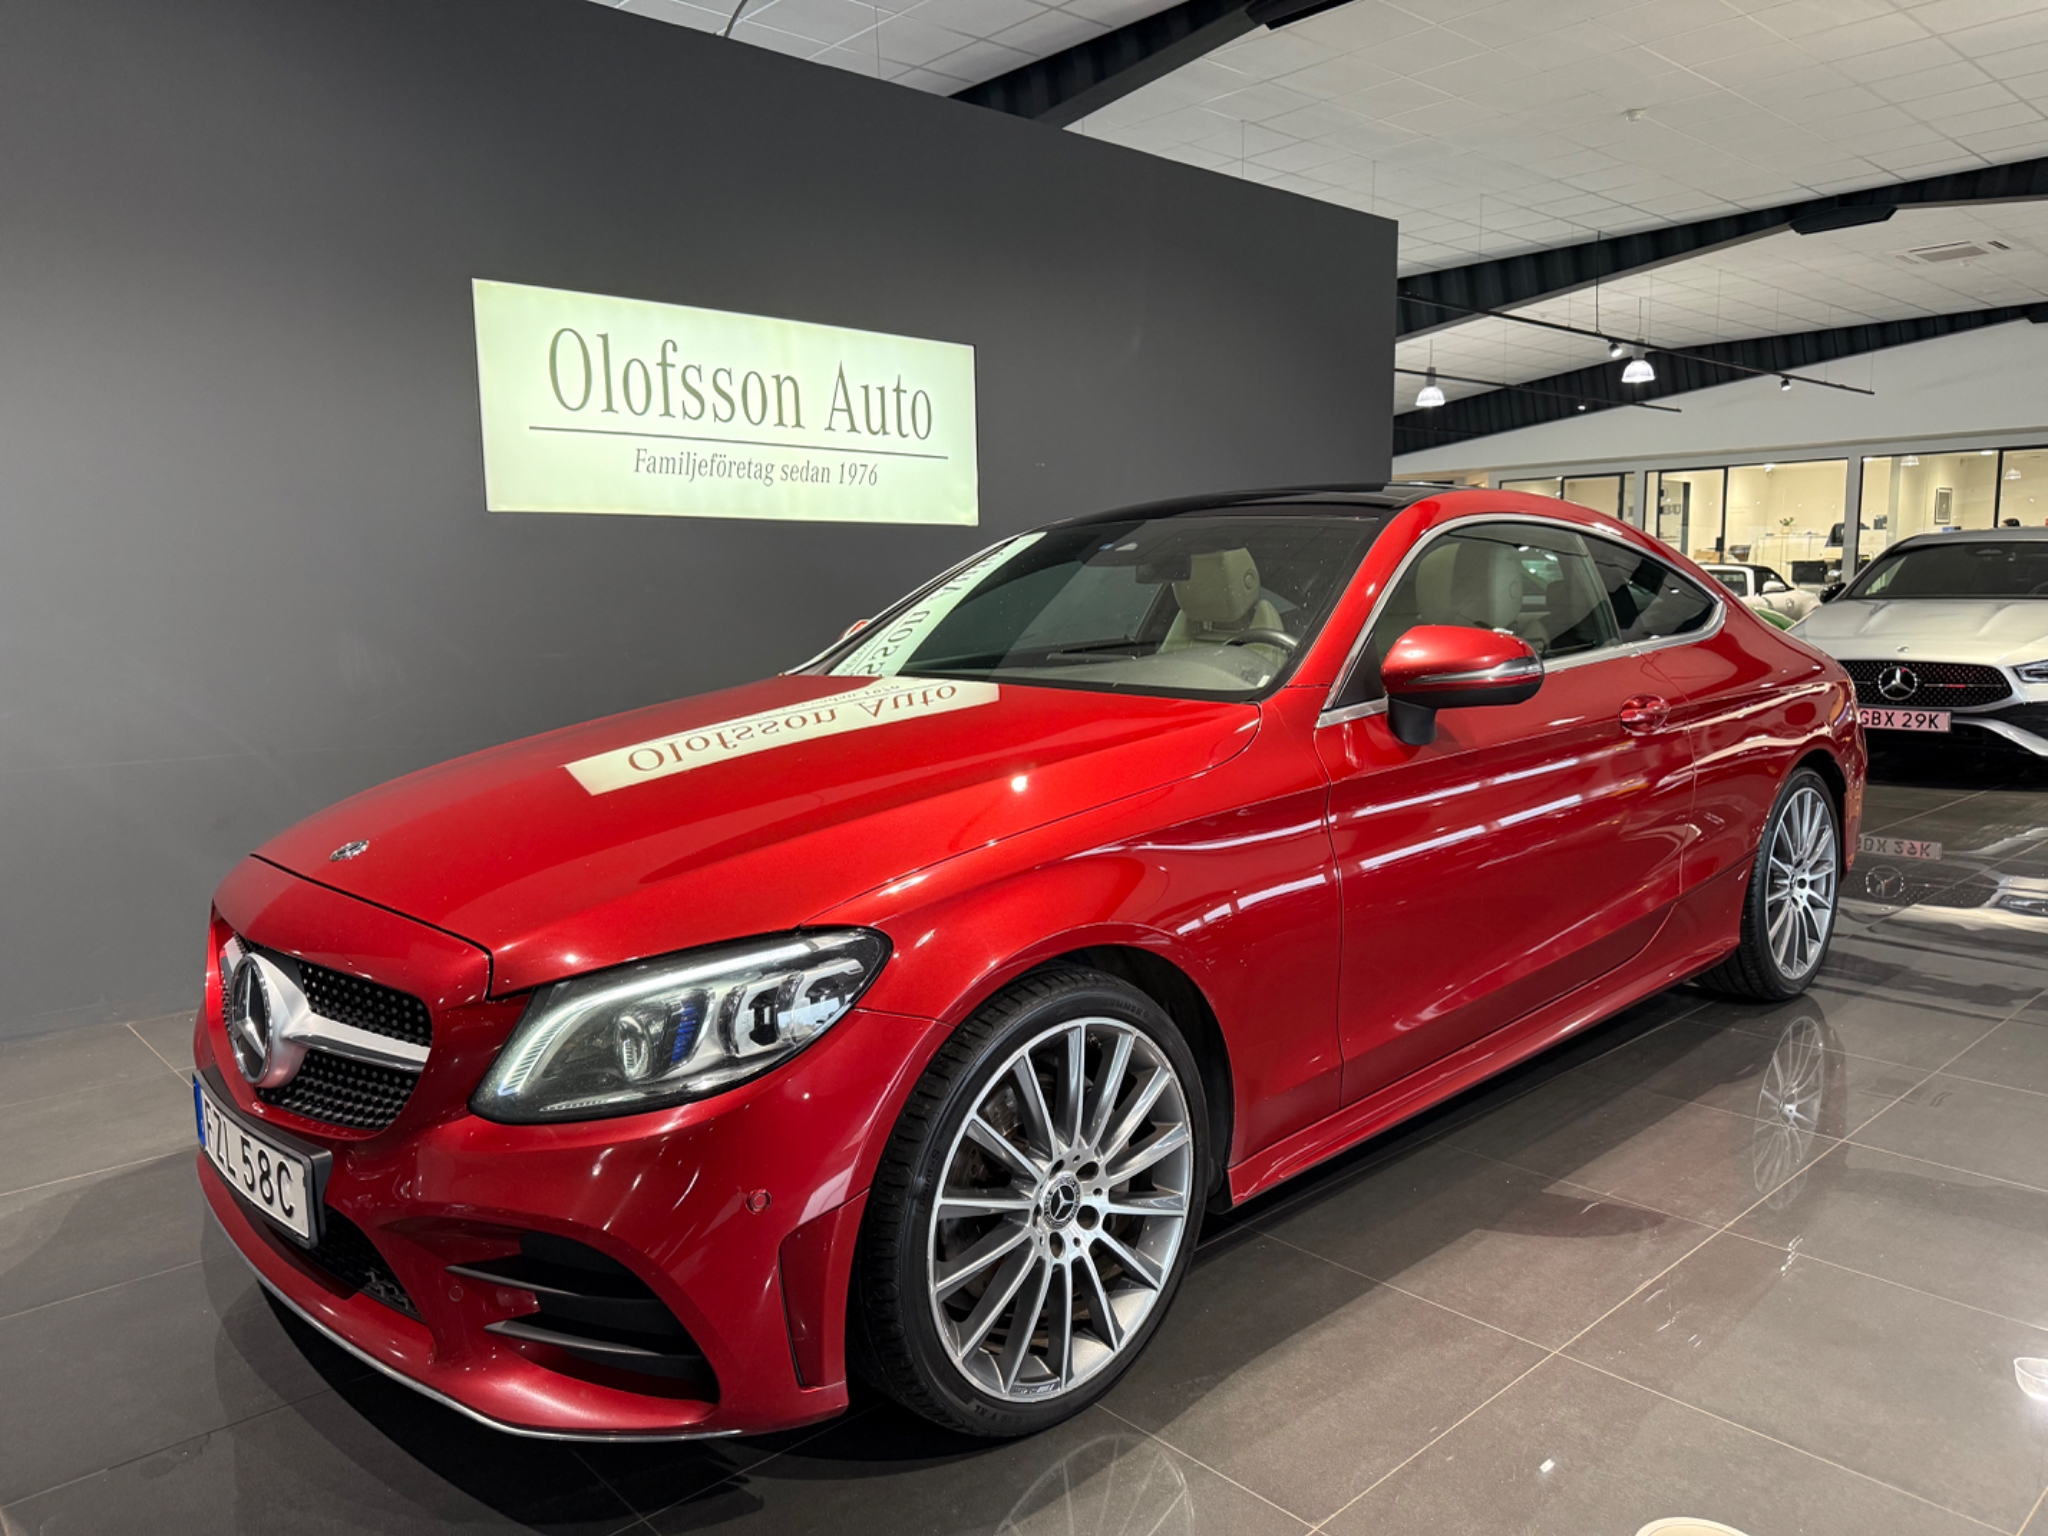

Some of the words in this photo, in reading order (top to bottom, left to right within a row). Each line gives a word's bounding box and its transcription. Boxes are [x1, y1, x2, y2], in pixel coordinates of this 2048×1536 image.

[549, 327, 805, 430] Olofsson
[824, 360, 932, 440] Auto
[634, 448, 774, 486] Familjeföretag
[780, 459, 831, 484] sedan
[838, 461, 878, 486] 1976
[1859, 710, 1895, 727] GBX
[1902, 712, 1939, 729] 29K
[204, 1097, 237, 1178] FZL
[240, 1134, 295, 1218] 58C
